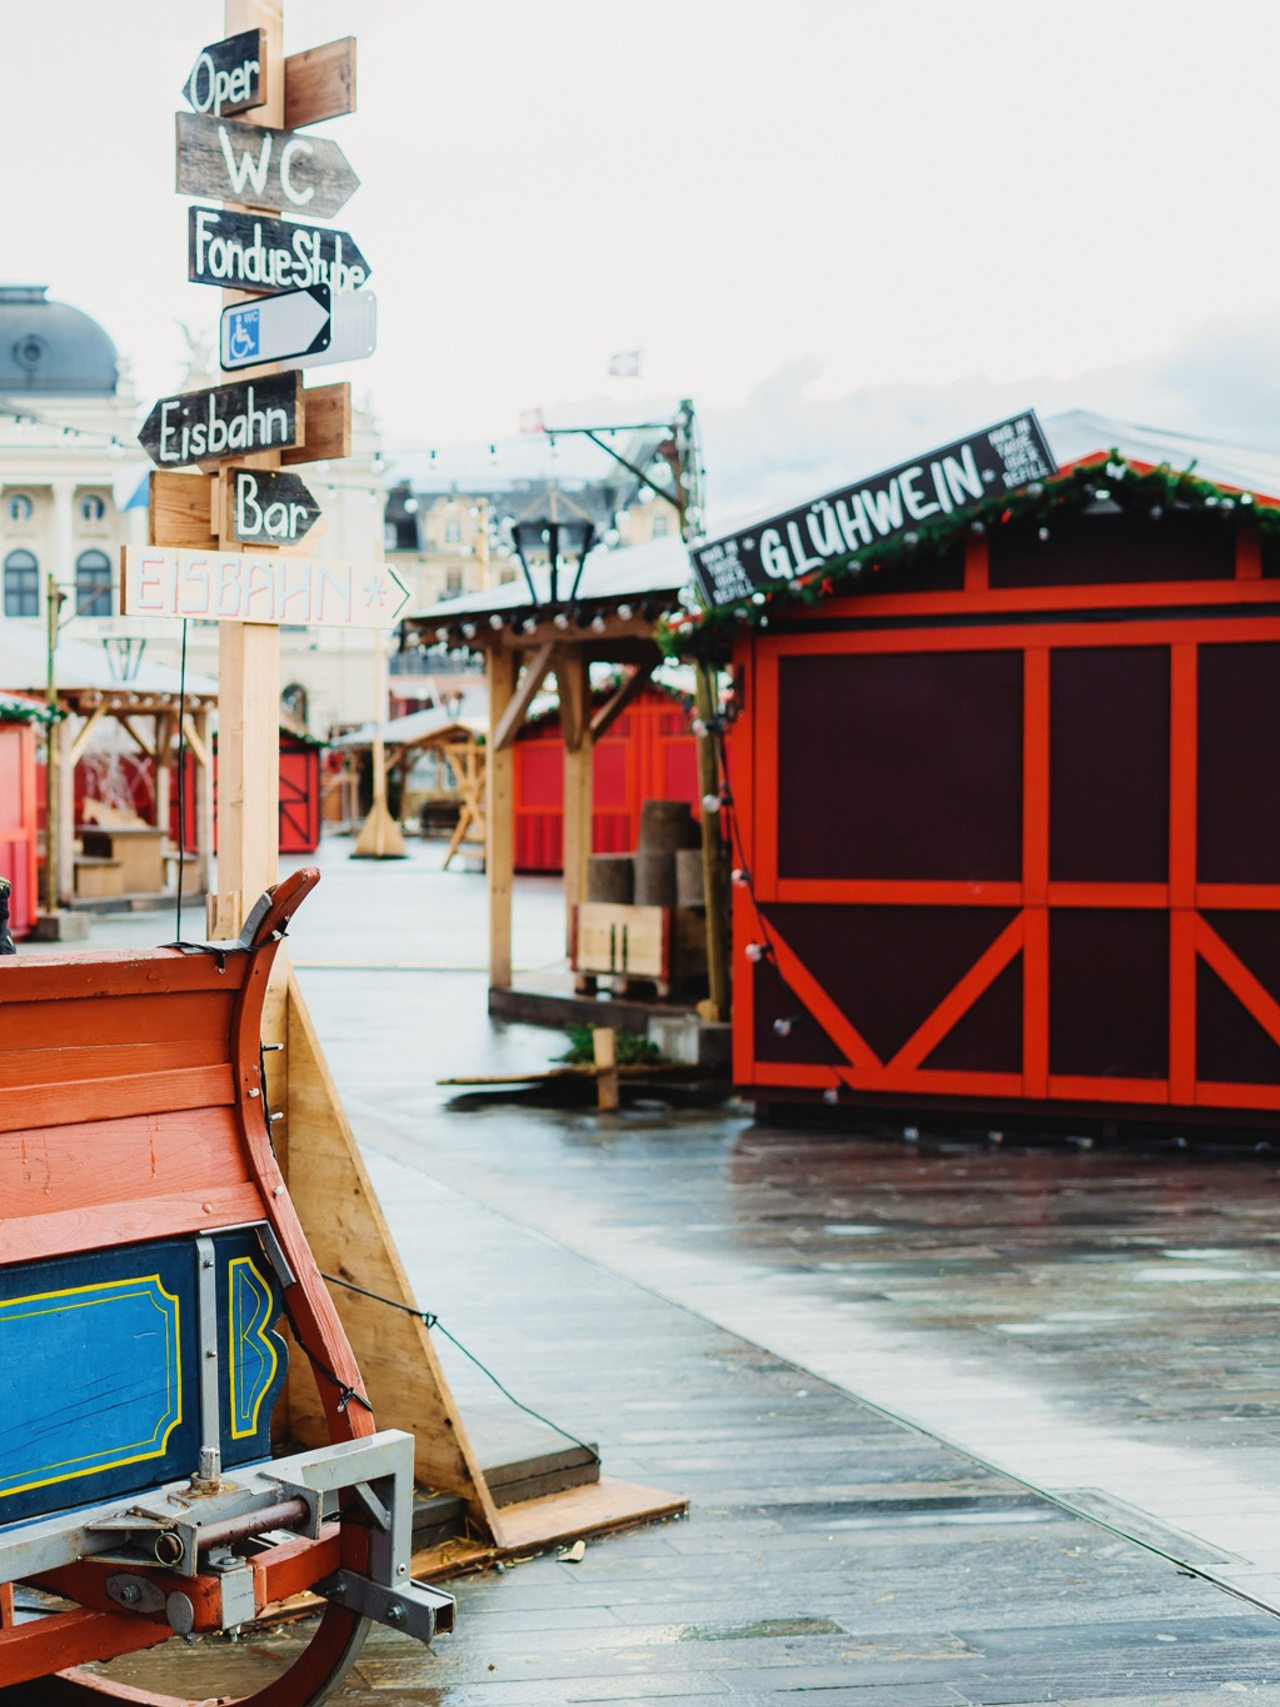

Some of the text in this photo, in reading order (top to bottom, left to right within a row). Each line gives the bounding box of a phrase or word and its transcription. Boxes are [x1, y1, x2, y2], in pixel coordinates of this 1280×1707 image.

[190, 52, 260, 117] Oper
[219, 125, 315, 206] WC
[159, 386, 288, 461] Eisbahn
[237, 474, 308, 538] Bar
[759, 444, 984, 579] GLÜHWEIN
[136, 554, 352, 622] EISBAHN
